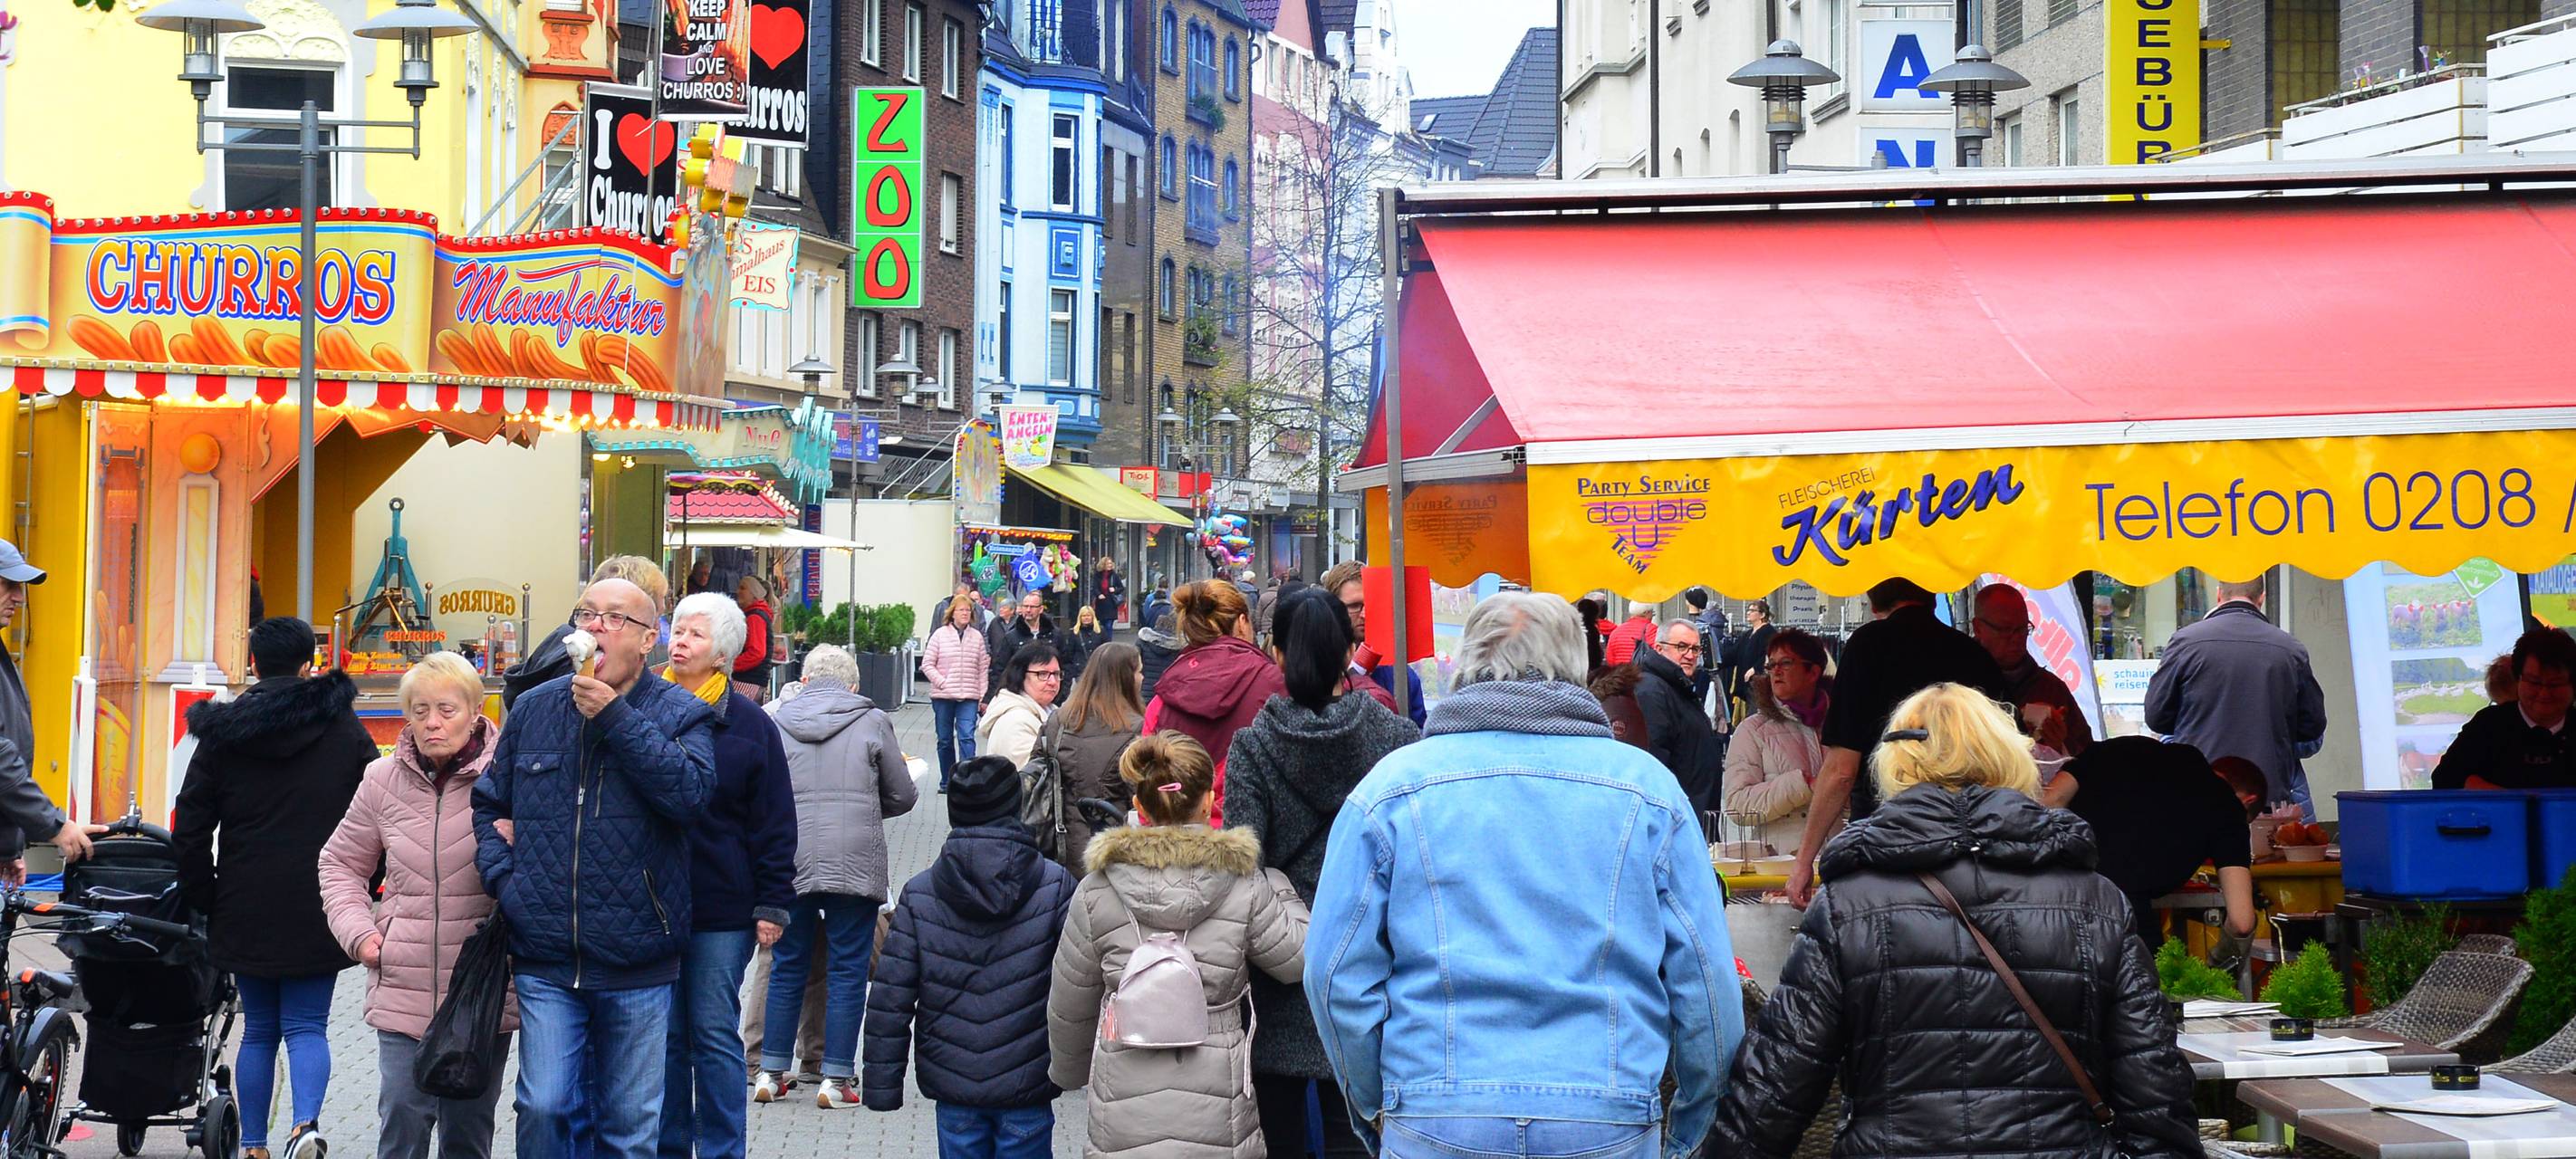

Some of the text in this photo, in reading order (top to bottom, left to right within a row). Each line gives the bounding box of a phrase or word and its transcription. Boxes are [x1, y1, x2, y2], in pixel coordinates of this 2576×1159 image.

[688, 0, 726, 17] KEEP
[686, 23, 726, 41] CALM
[698, 44, 713, 53] AND
[687, 57, 726, 75] LOVE
[663, 81, 734, 100] CHURROS
[729, 85, 805, 133] urros
[594, 109, 613, 169] I
[864, 93, 911, 299] ZOO
[86, 237, 396, 326] CHURROS
[743, 274, 775, 294] EIS
[452, 258, 667, 348] Manufaktur
[1006, 424, 1053, 439] ANGELN
[1778, 466, 1876, 509] FLEISCHEREI
[1587, 498, 1706, 523] double
[1772, 463, 2025, 567] Kürten
[2085, 478, 2335, 541] Telefon
[2363, 468, 2536, 532] 0208
[1611, 533, 1648, 574] TEAM
[384, 630, 447, 643] CHURROS
[2114, 668, 2155, 679] schauin
